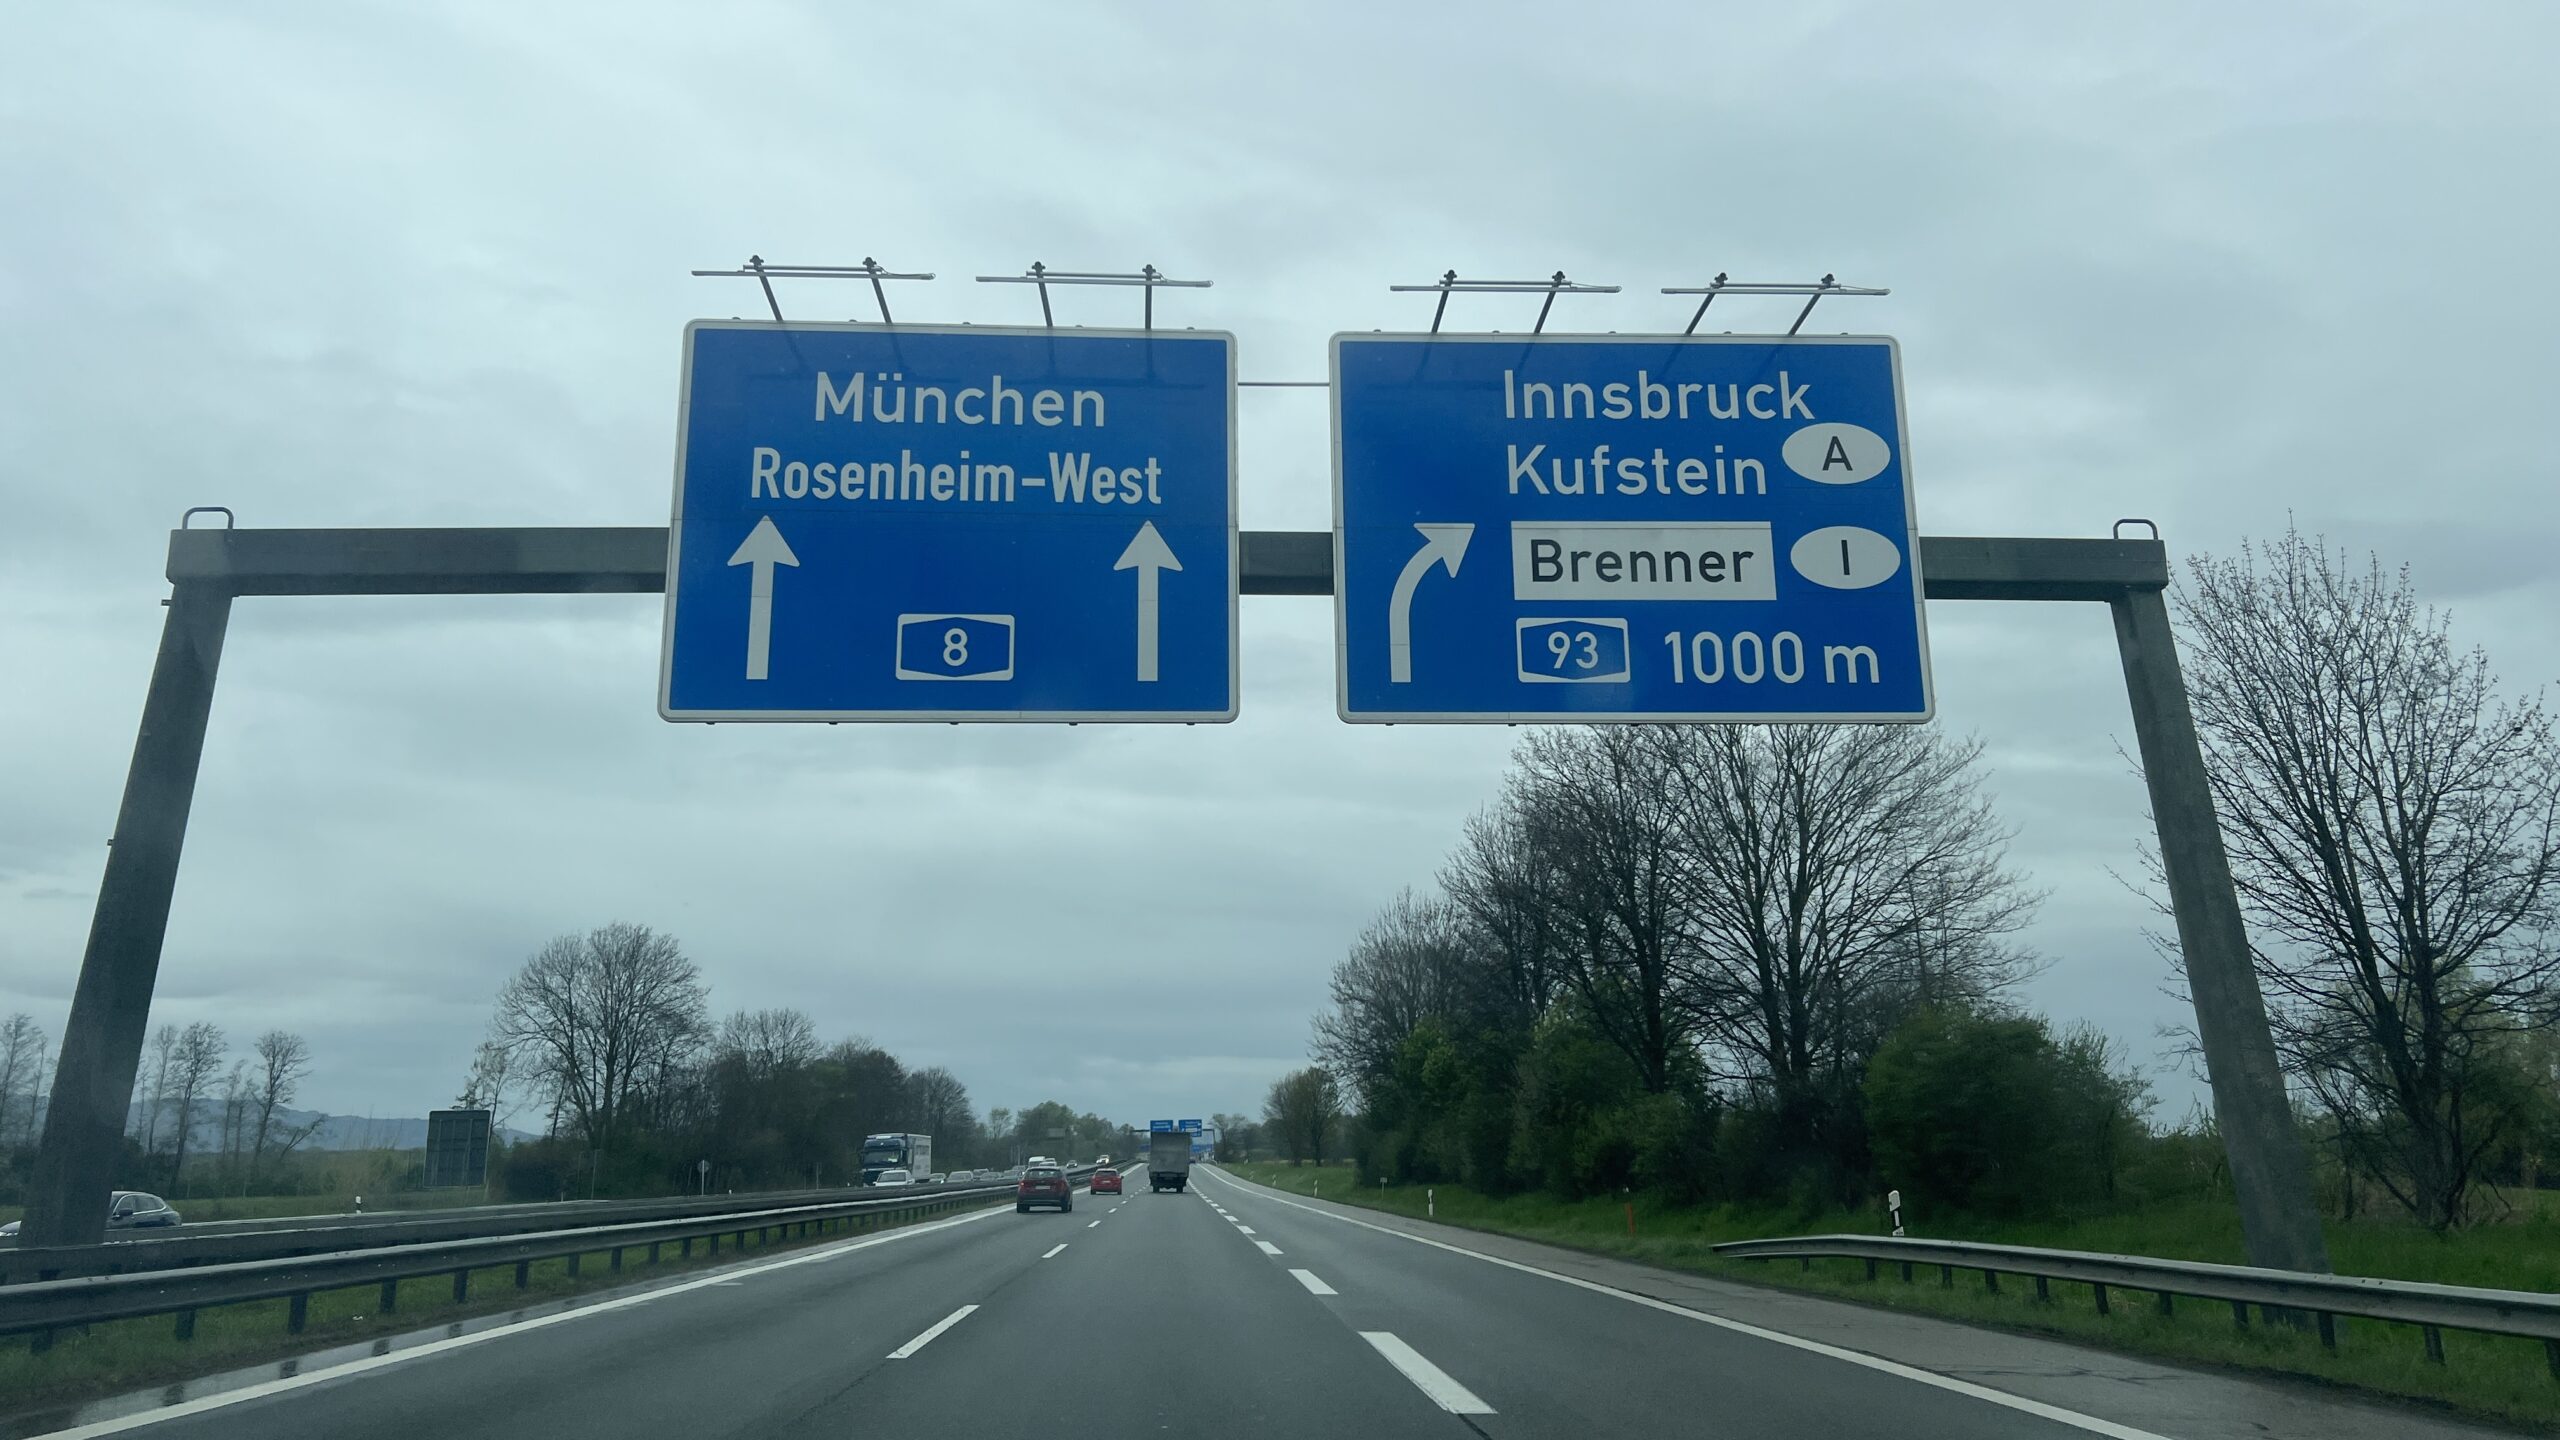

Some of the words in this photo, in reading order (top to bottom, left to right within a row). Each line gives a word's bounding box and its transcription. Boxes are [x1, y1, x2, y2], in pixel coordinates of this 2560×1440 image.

[816, 371, 1105, 427] München
[1504, 369, 1814, 419] Innsbruck
[751, 447, 1162, 504] Rosenheim-West
[1508, 444, 1766, 495] Kufstein
[1822, 436, 1853, 471] A
[1531, 539, 1753, 582] Brenner
[1841, 539, 1851, 576] I
[943, 628, 968, 666] 8
[1547, 631, 1599, 669] 93
[1665, 631, 1804, 684] 1000
[1825, 645, 1880, 683] m
